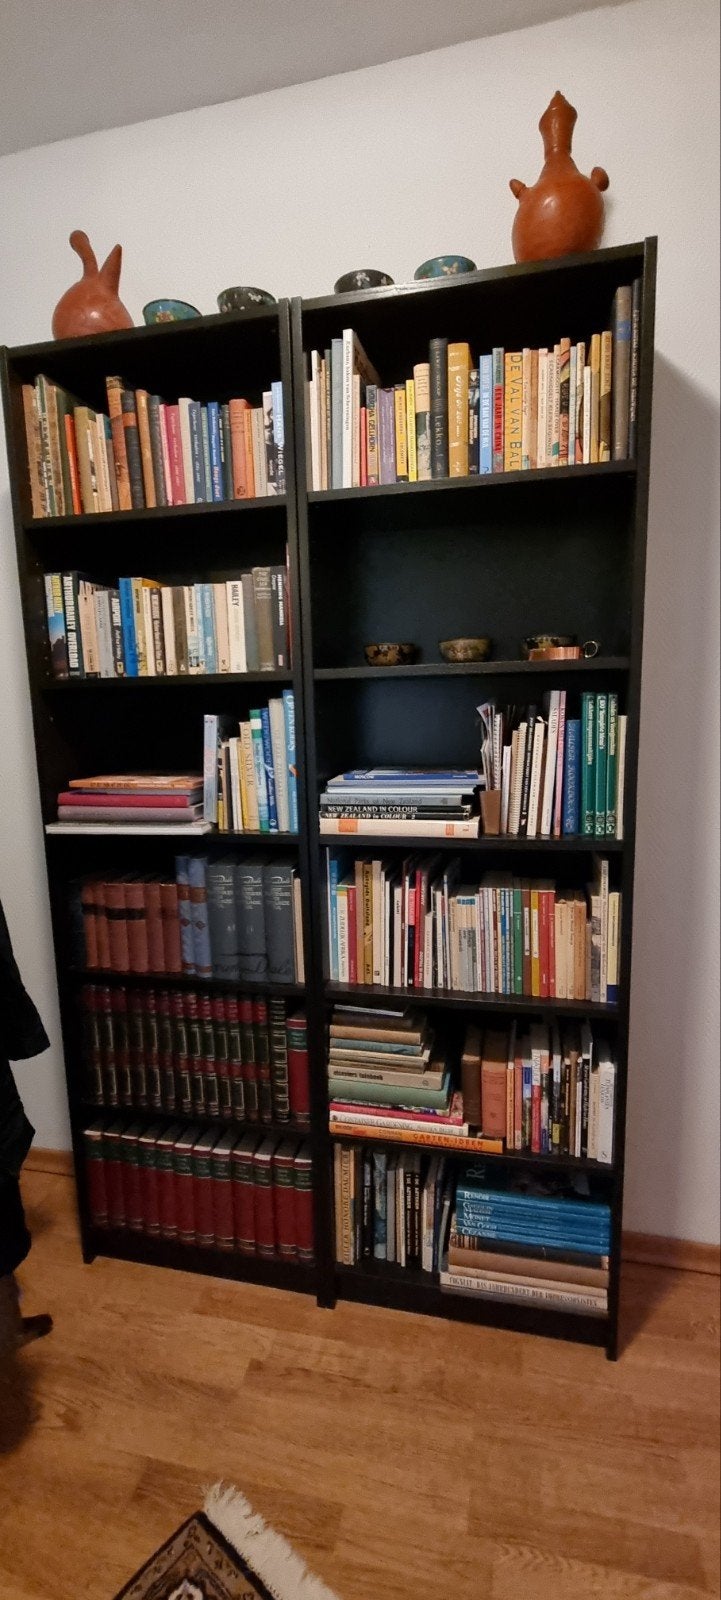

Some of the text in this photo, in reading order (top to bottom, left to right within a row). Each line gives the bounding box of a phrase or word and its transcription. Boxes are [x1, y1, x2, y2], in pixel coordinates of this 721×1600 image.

[510, 355, 522, 372] DE
[510, 376, 522, 403] VAL
[510, 409, 522, 434] VAN
[276, 442, 284, 475] WIEGEL
[63, 576, 78, 668] ARTHUR HAILEY OVERLOAD
[112, 598, 121, 626] AIRPORT
[243, 729, 254, 787] OLD SILVER
